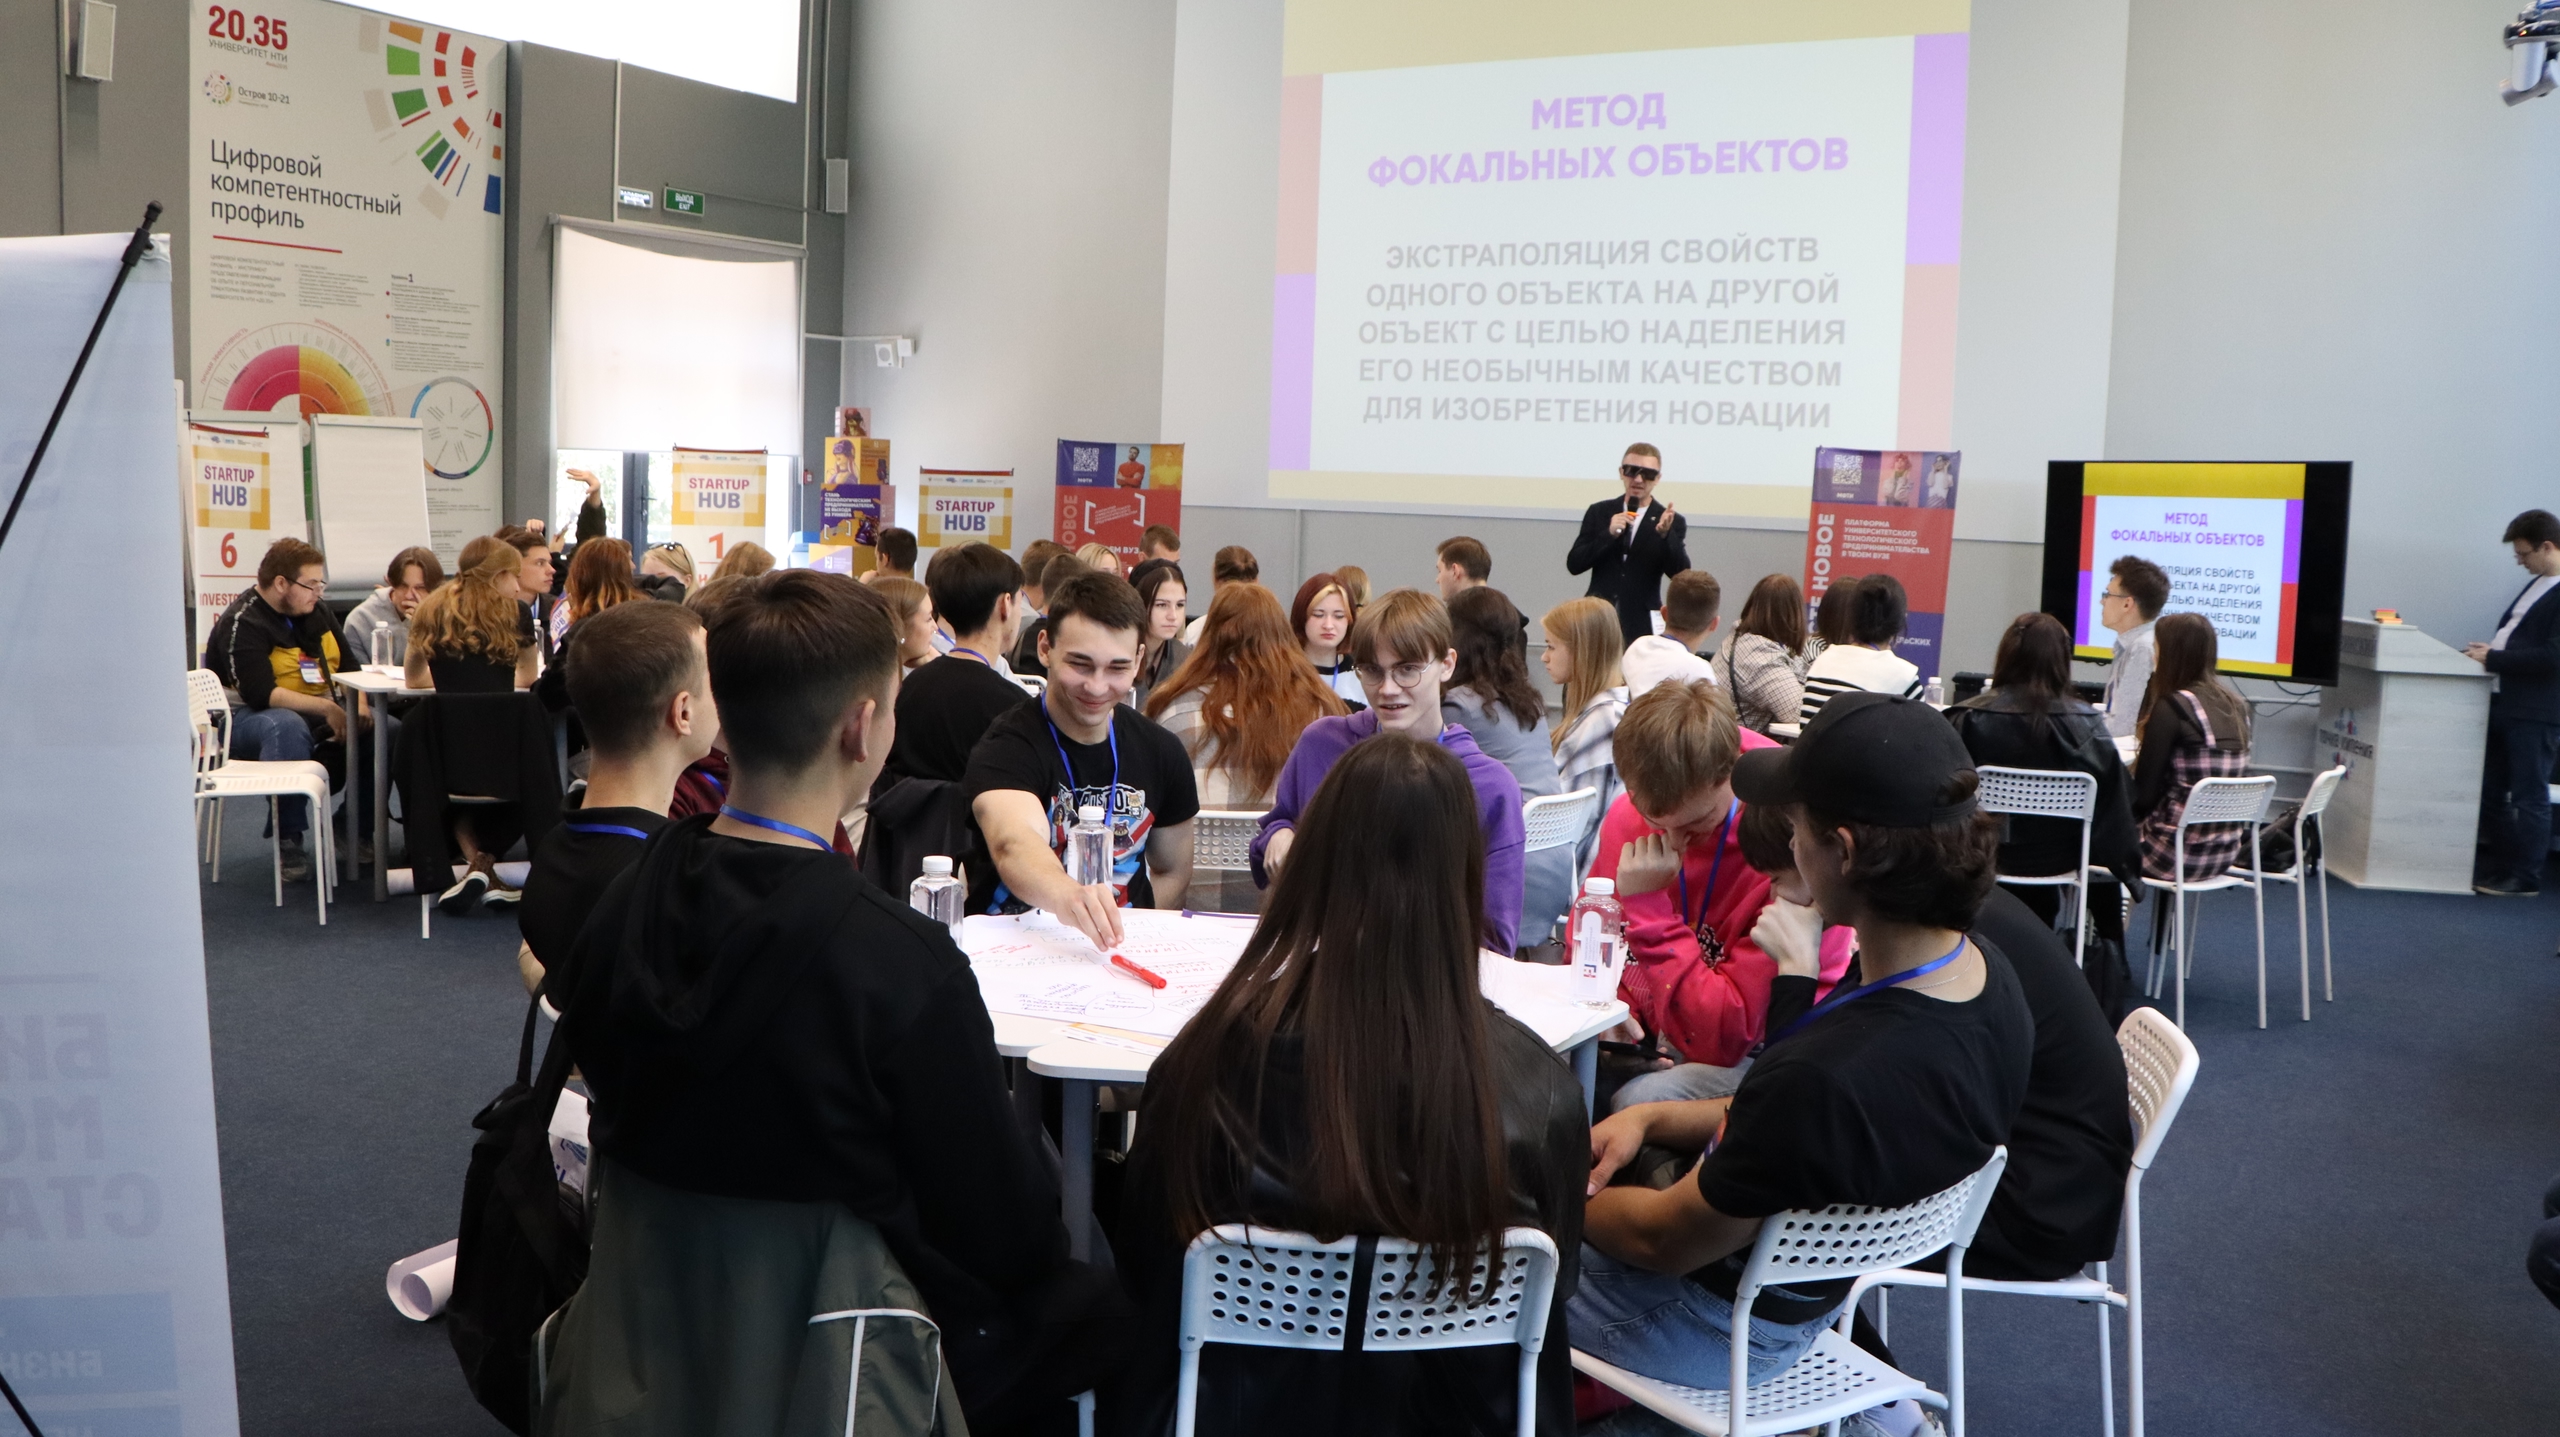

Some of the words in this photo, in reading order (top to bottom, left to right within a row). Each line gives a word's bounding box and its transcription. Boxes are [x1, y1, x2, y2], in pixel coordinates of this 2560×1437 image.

[208, 5, 288, 51] 20.35
[208, 39, 268, 58] УНИВЕРСИТЕТ
[270, 52, 288, 62] НТИ
[238, 86, 266, 99] Остров
[267, 92, 290, 104] 10-21
[1532, 92, 1667, 131] МЕТОД
[211, 138, 321, 179] Цифровой
[1368, 146, 1616, 187] ФОКАЛЬНЫХ
[1628, 137, 1849, 177] ОБЪЕКТОВ
[211, 173, 401, 216] компетентностный
[675, 192, 694, 205] ВЫХОД
[211, 201, 305, 229] профиль
[1386, 240, 1650, 269] ЭКСТРАПОЛЯЦИЯ
[1660, 232, 1819, 264] СВОЙСТВ
[408, 273, 414, 282] 1
[1366, 282, 1487, 311] ОДНОГО
[1497, 280, 1644, 306] ОБЪЕКТА
[1654, 279, 1698, 304] НА
[1706, 272, 1839, 309] ДРУГОЙ
[1359, 320, 1478, 344] ОБЪЕКТ
[1486, 319, 1506, 343] С
[1515, 319, 1630, 348] ЦЕЛЬЮ
[1640, 319, 1846, 349] НАДЕЛЕНИЯ
[1359, 358, 1413, 382] ЕГО
[1422, 358, 1630, 383] НЕОБЫЧНЫМ
[1641, 360, 1842, 386] КАЧЕСТВОМ
[1363, 397, 1422, 423] ДЛЯ
[1432, 397, 1657, 424] ИЗОБРЕТЕНИЯ
[1668, 400, 1831, 432] НОВАЦИИ
[204, 465, 255, 483] STARTUP
[689, 477, 750, 490] STARTUP
[212, 483, 247, 507] HUB
[698, 492, 741, 509] HUB
[935, 499, 996, 513] STARTUP
[944, 514, 986, 531] HUB
[1844, 518, 1890, 528] ПЛАТФОРМА
[2164, 512, 2209, 527] МЕТОД
[1843, 534, 1918, 545] ТЕХНОЛОГИЧЕСКОГО
[1844, 526, 1918, 538] УНИВЕРСИТЕТСКОГО
[2111, 529, 2192, 544] ФОКАЛЬНЫХ
[2195, 532, 2265, 547] ОБЪЕКТОВ
[220, 532, 238, 569] 6
[709, 531, 724, 560] 1
[1811, 513, 1835, 590] НОВОЕ
[1842, 542, 1930, 554] ПРЕДПРИНИМАТЕЛЬСТВА
[1848, 551, 1872, 559] ТВОЕМ
[1873, 552, 1890, 560] ВУЗЕ
[2160, 565, 2202, 577] ОЛЯЦИЯ
[2204, 566, 2255, 580] СВОЙСТВ
[2201, 582, 2216, 591] НА
[2219, 583, 2261, 595] ДРУГОЙ
[2167, 595, 2195, 606] ЕЛЬЮ
[2197, 596, 2262, 610] НАДЕЛЕНИЯ
[2215, 627, 2257, 640] ОВАЦИИ
